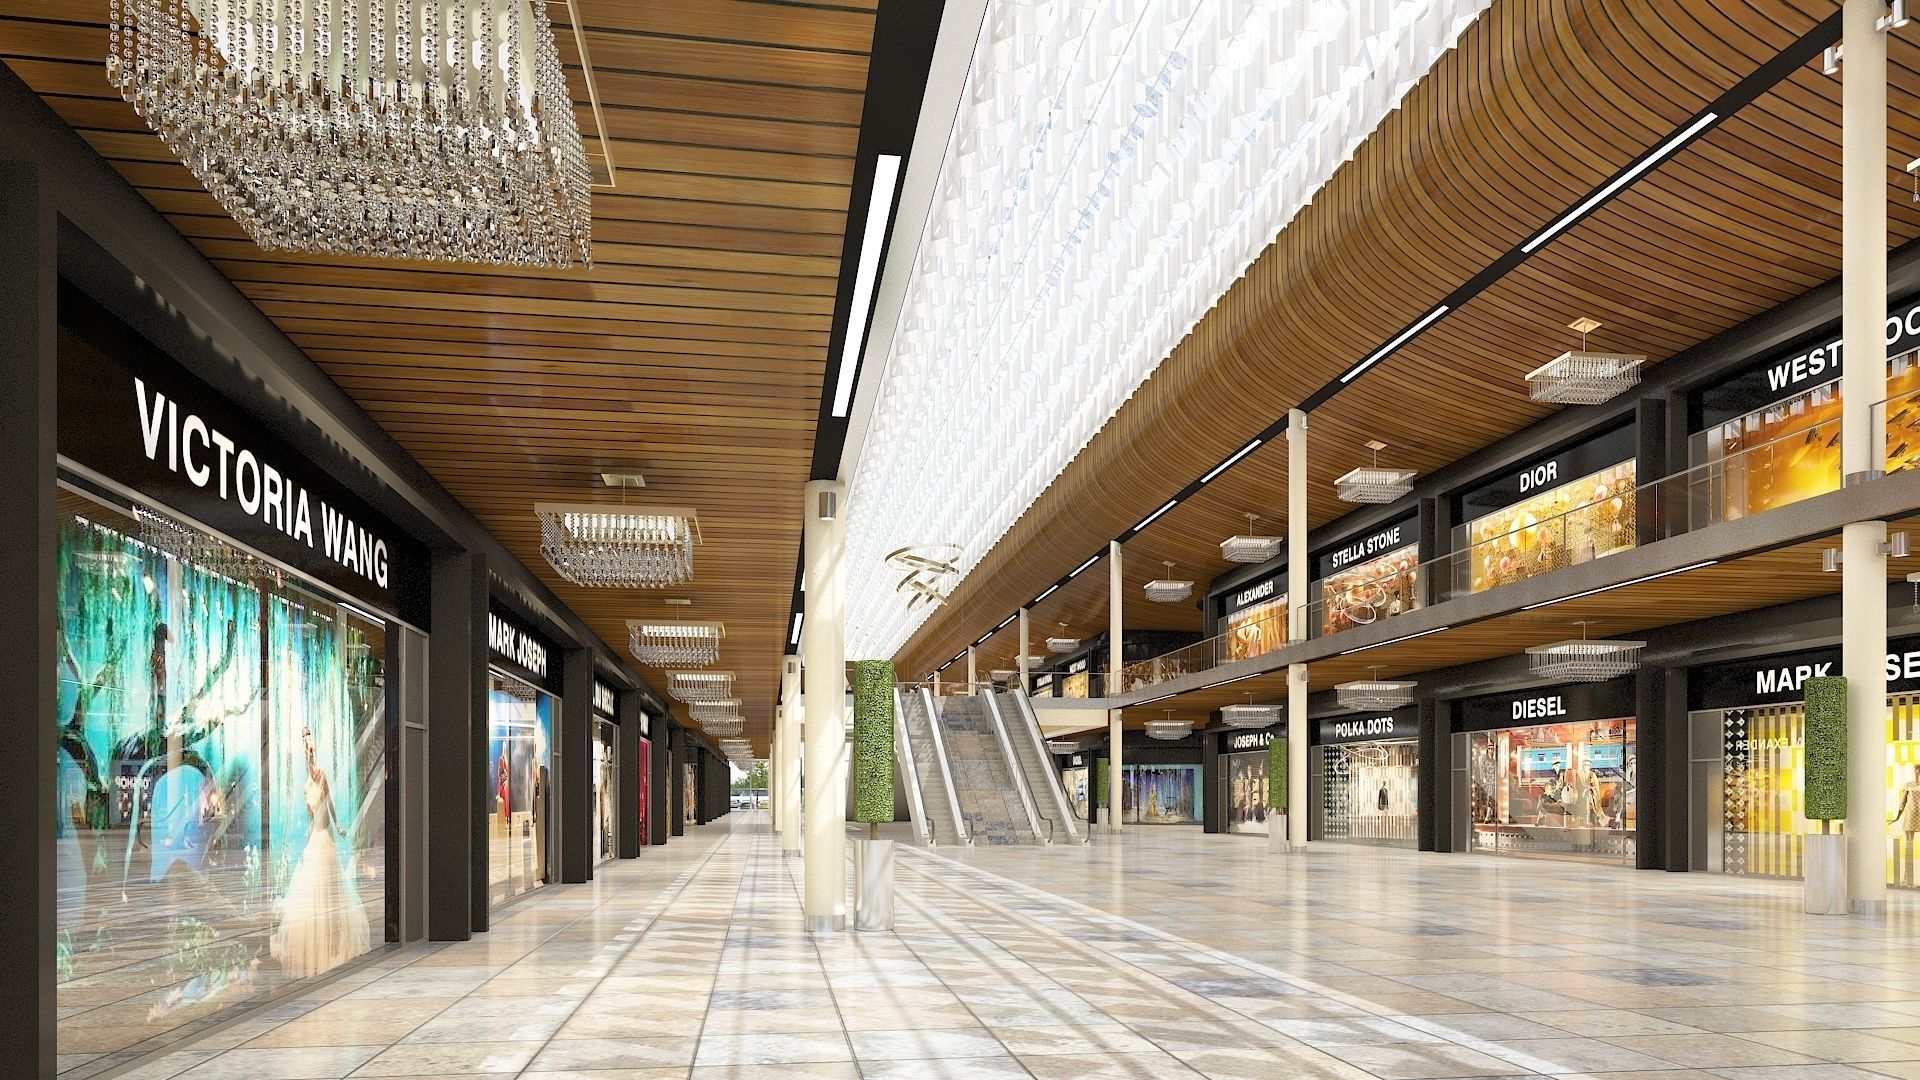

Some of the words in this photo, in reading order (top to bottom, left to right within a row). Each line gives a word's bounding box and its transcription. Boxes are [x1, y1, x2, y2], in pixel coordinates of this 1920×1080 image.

[1767, 339, 1843, 391] WEST
[134, 377, 313, 548] VICTORIA
[321, 501, 388, 589] WANG
[1520, 461, 1557, 493] DIOR
[1332, 542, 1365, 568] STELLA
[1367, 527, 1400, 554] STONE
[1236, 581, 1274, 607] ALEXANDER
[488, 611, 515, 661] MARK
[517, 632, 546, 678] JOSEPH
[1512, 696, 1566, 720] DIESEL
[1233, 734, 1258, 748] JOSEPH
[1259, 733, 1264, 746] &
[1335, 721, 1365, 738] POLKA
[1367, 717, 1394, 735] DOTS
